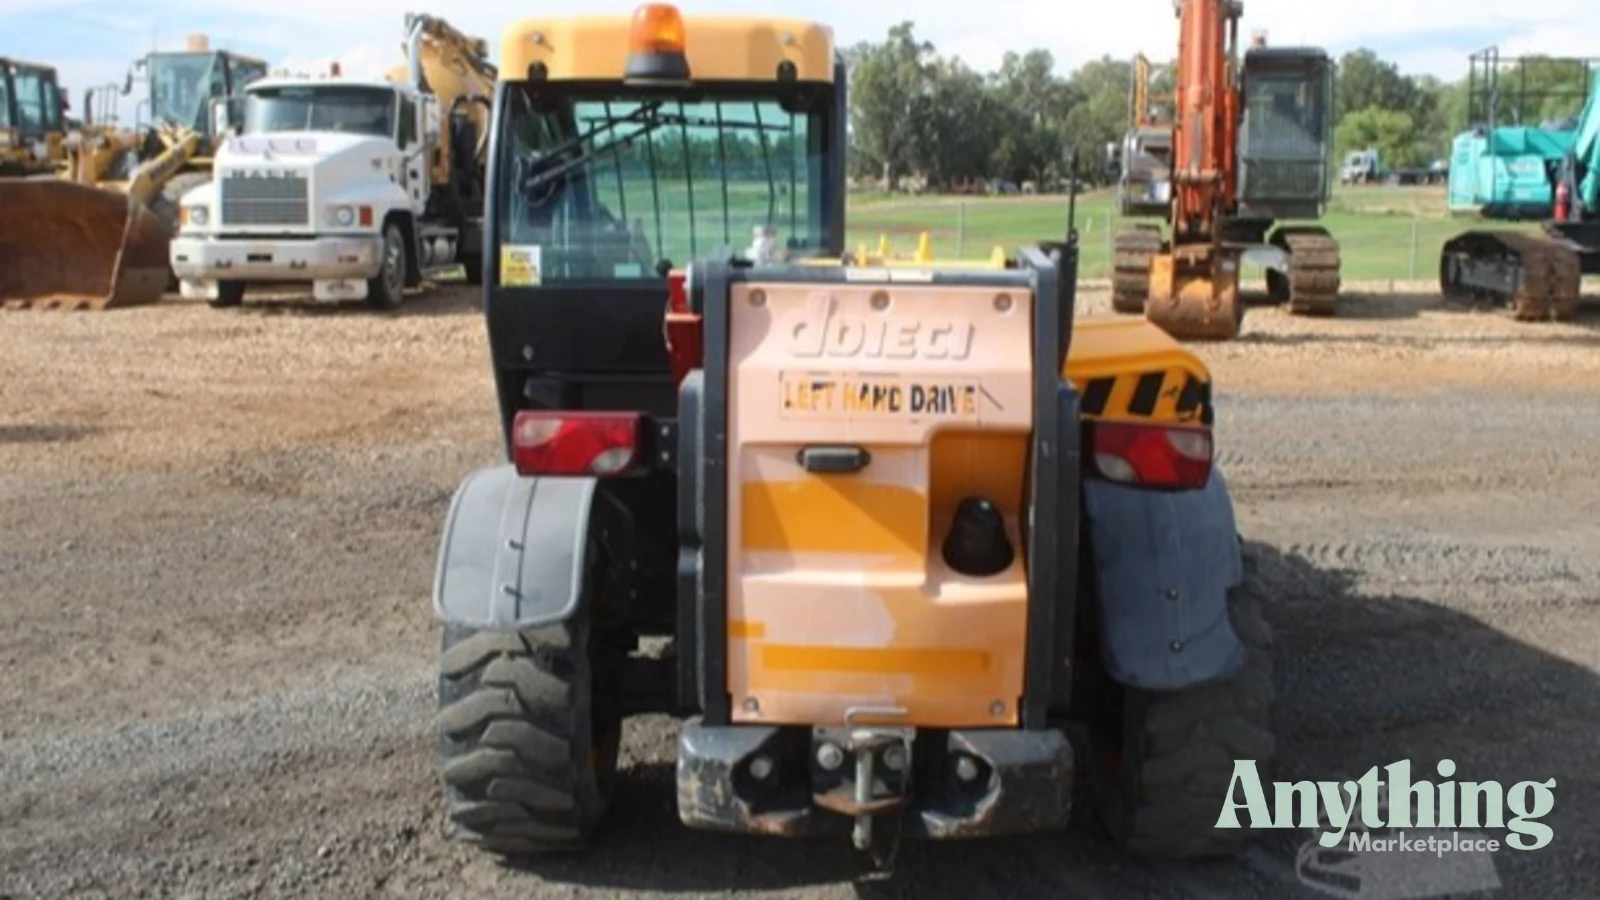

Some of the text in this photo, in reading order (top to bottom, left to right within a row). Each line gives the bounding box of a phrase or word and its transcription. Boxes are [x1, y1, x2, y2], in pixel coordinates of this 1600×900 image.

[784, 381, 976, 414] LEFT HAND DRIVE
